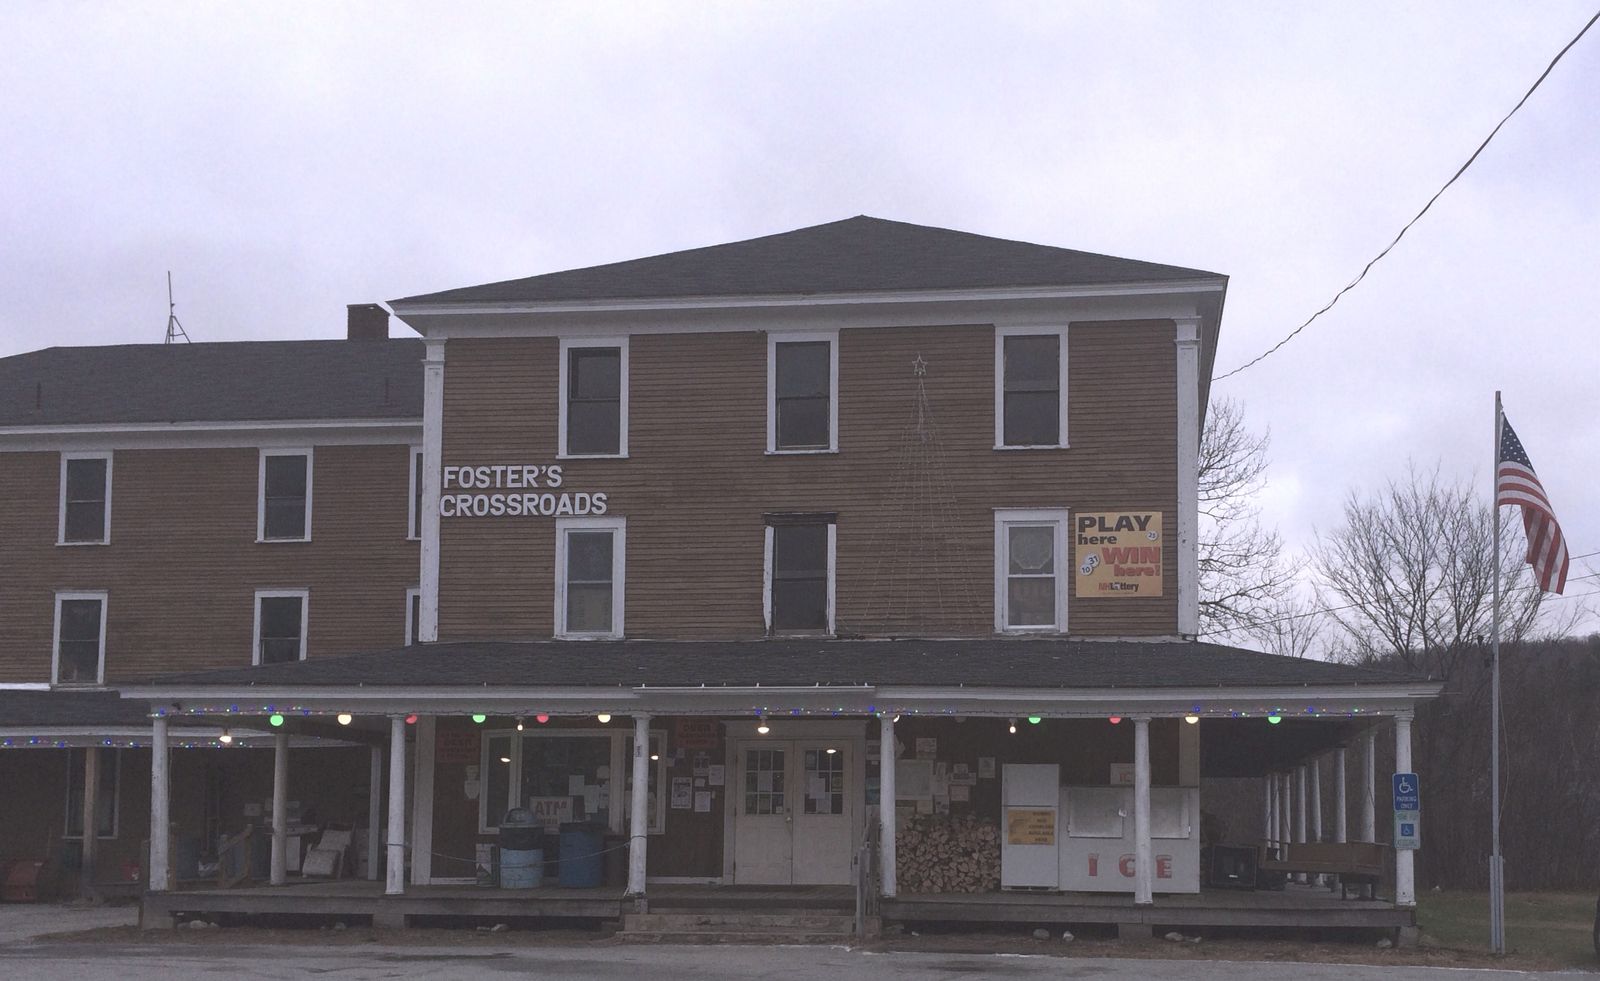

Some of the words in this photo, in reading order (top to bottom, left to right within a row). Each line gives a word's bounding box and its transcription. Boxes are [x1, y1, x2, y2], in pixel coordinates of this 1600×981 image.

[443, 465, 563, 489] FOSTER'S
[440, 492, 607, 517] CROSSROADS
[1078, 516, 1151, 532] PLAY
[1077, 533, 1117, 545] here
[1102, 547, 1160, 564] WIN
[1114, 565, 1160, 576] here!
[1088, 854, 1172, 879] ICE
